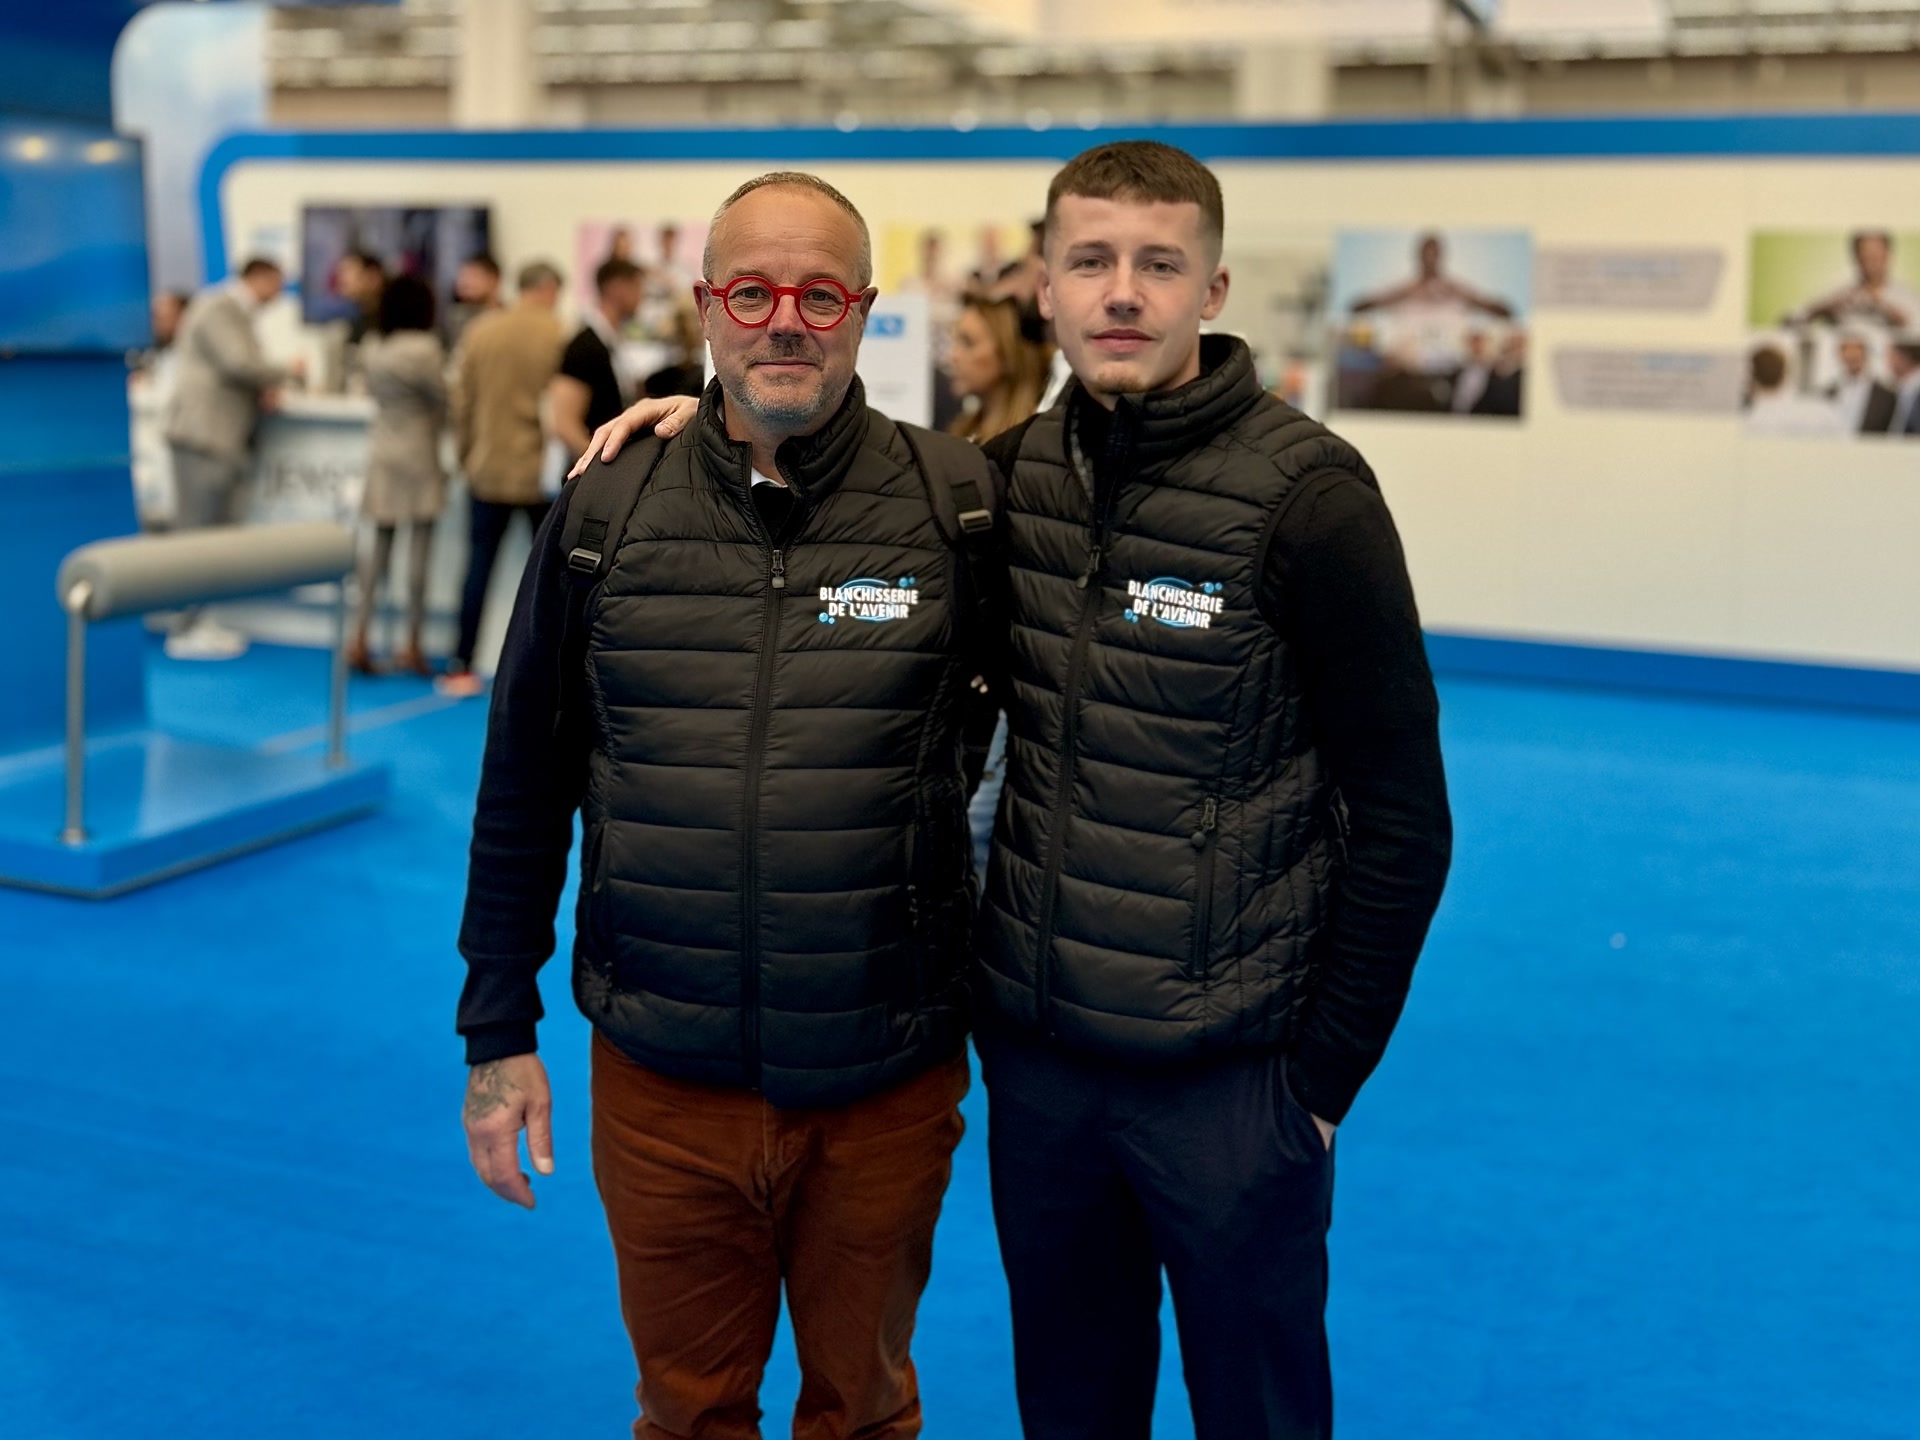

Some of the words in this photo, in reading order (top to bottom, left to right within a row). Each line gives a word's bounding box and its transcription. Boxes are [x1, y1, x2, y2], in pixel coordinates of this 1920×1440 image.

[820, 587, 919, 605] BLANCHISSERIE
[1128, 580, 1224, 613] BLANCHISSERIE
[828, 602, 845, 616] DE
[850, 603, 909, 618] L'AVENIR
[1133, 599, 1150, 616] DE
[1151, 603, 1211, 629] L'AVENIR
